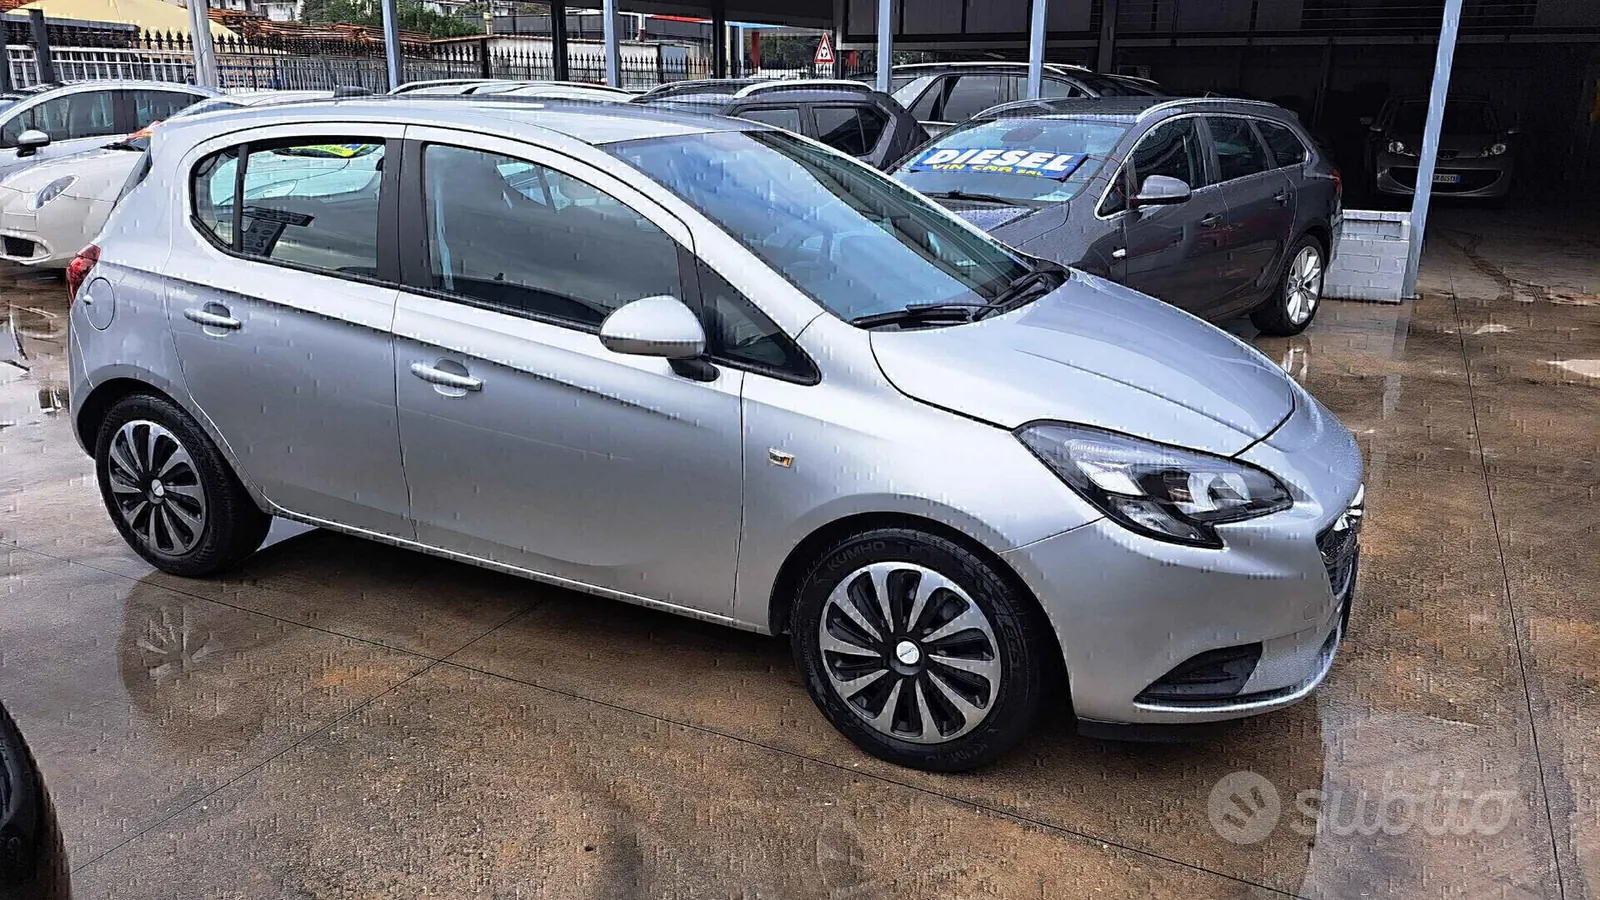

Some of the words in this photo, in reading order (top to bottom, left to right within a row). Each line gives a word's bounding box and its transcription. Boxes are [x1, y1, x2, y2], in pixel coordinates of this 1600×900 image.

[922, 149, 1074, 172] DIESEL
[971, 165, 1013, 173] CAR
[826, 540, 887, 571] KUMHO
